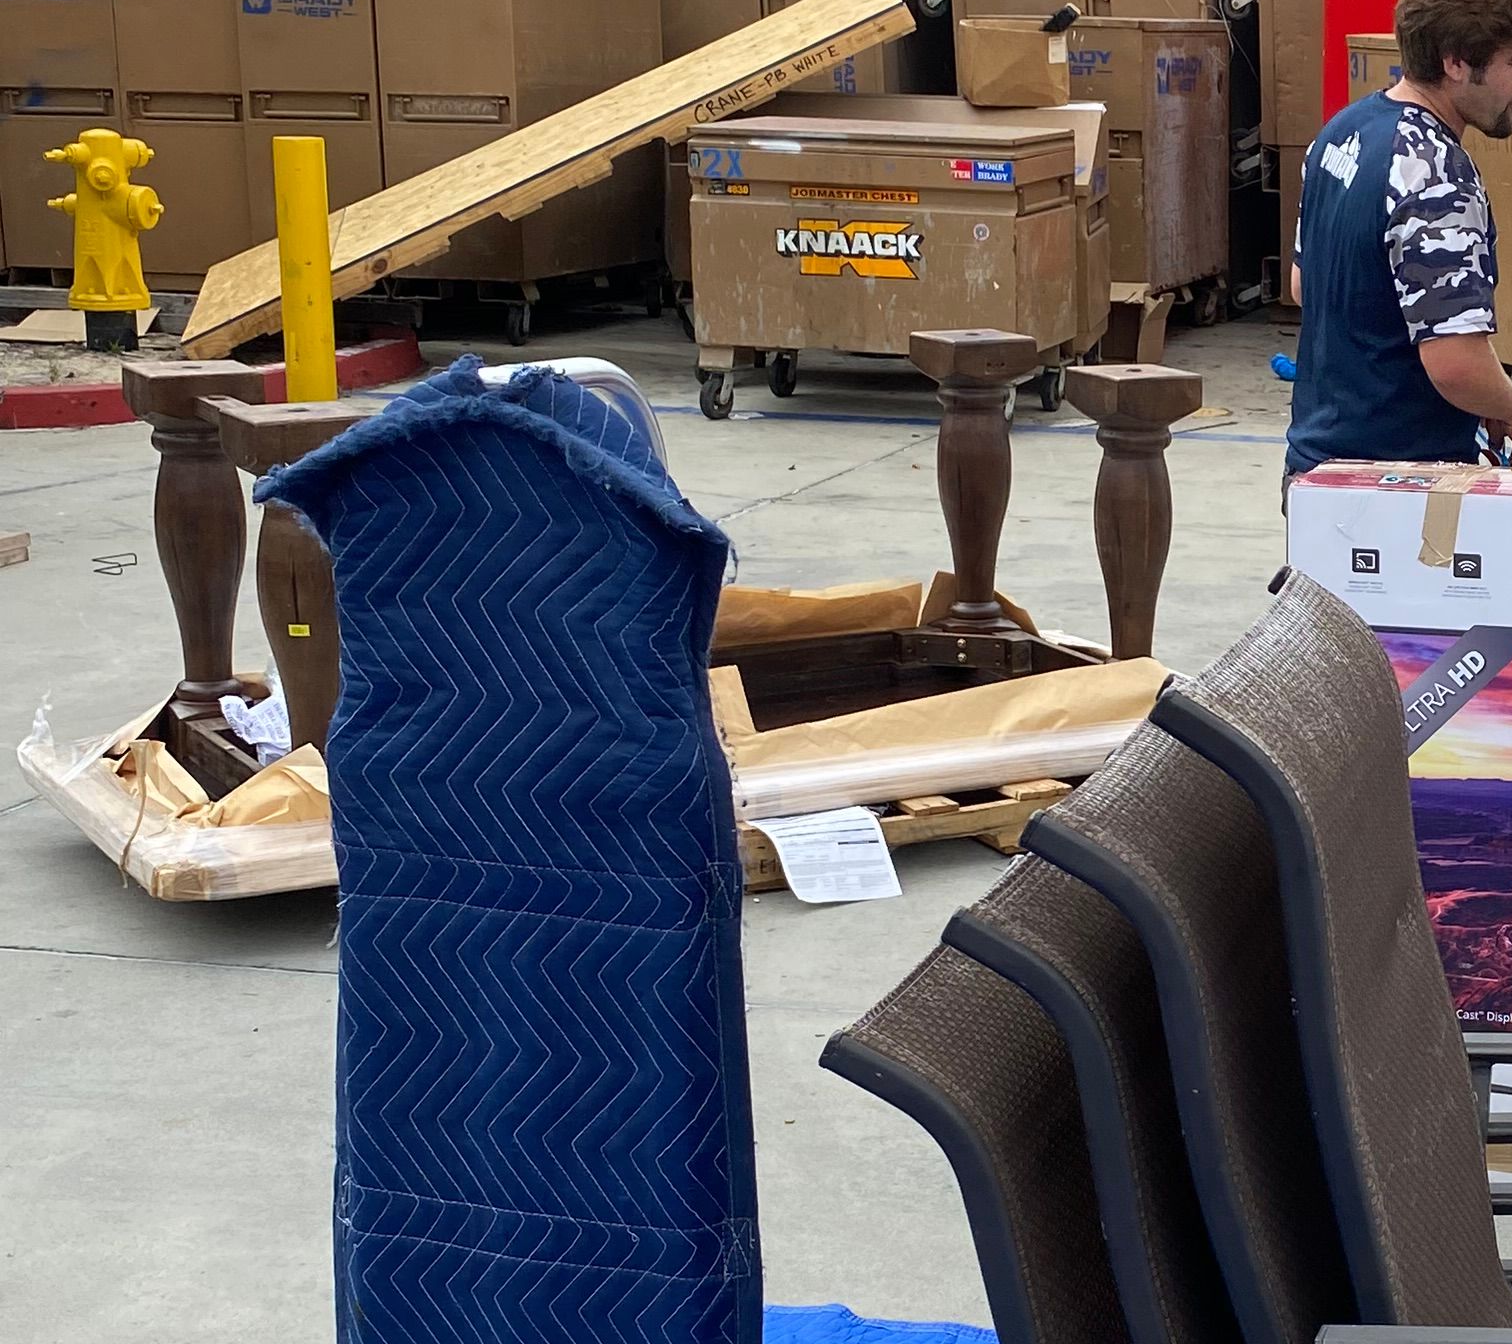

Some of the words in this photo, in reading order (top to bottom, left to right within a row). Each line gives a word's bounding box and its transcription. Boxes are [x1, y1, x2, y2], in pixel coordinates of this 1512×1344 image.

[293, 5, 344, 18] WEST
[792, 44, 841, 74] WHITE
[977, 171, 1009, 181] BRADY
[791, 186, 869, 202] JOBMASTER
[870, 190, 916, 203] CHEST
[775, 227, 924, 260] KNAACK
[1404, 682, 1456, 732] LTRA
[1447, 650, 1486, 688] HD
